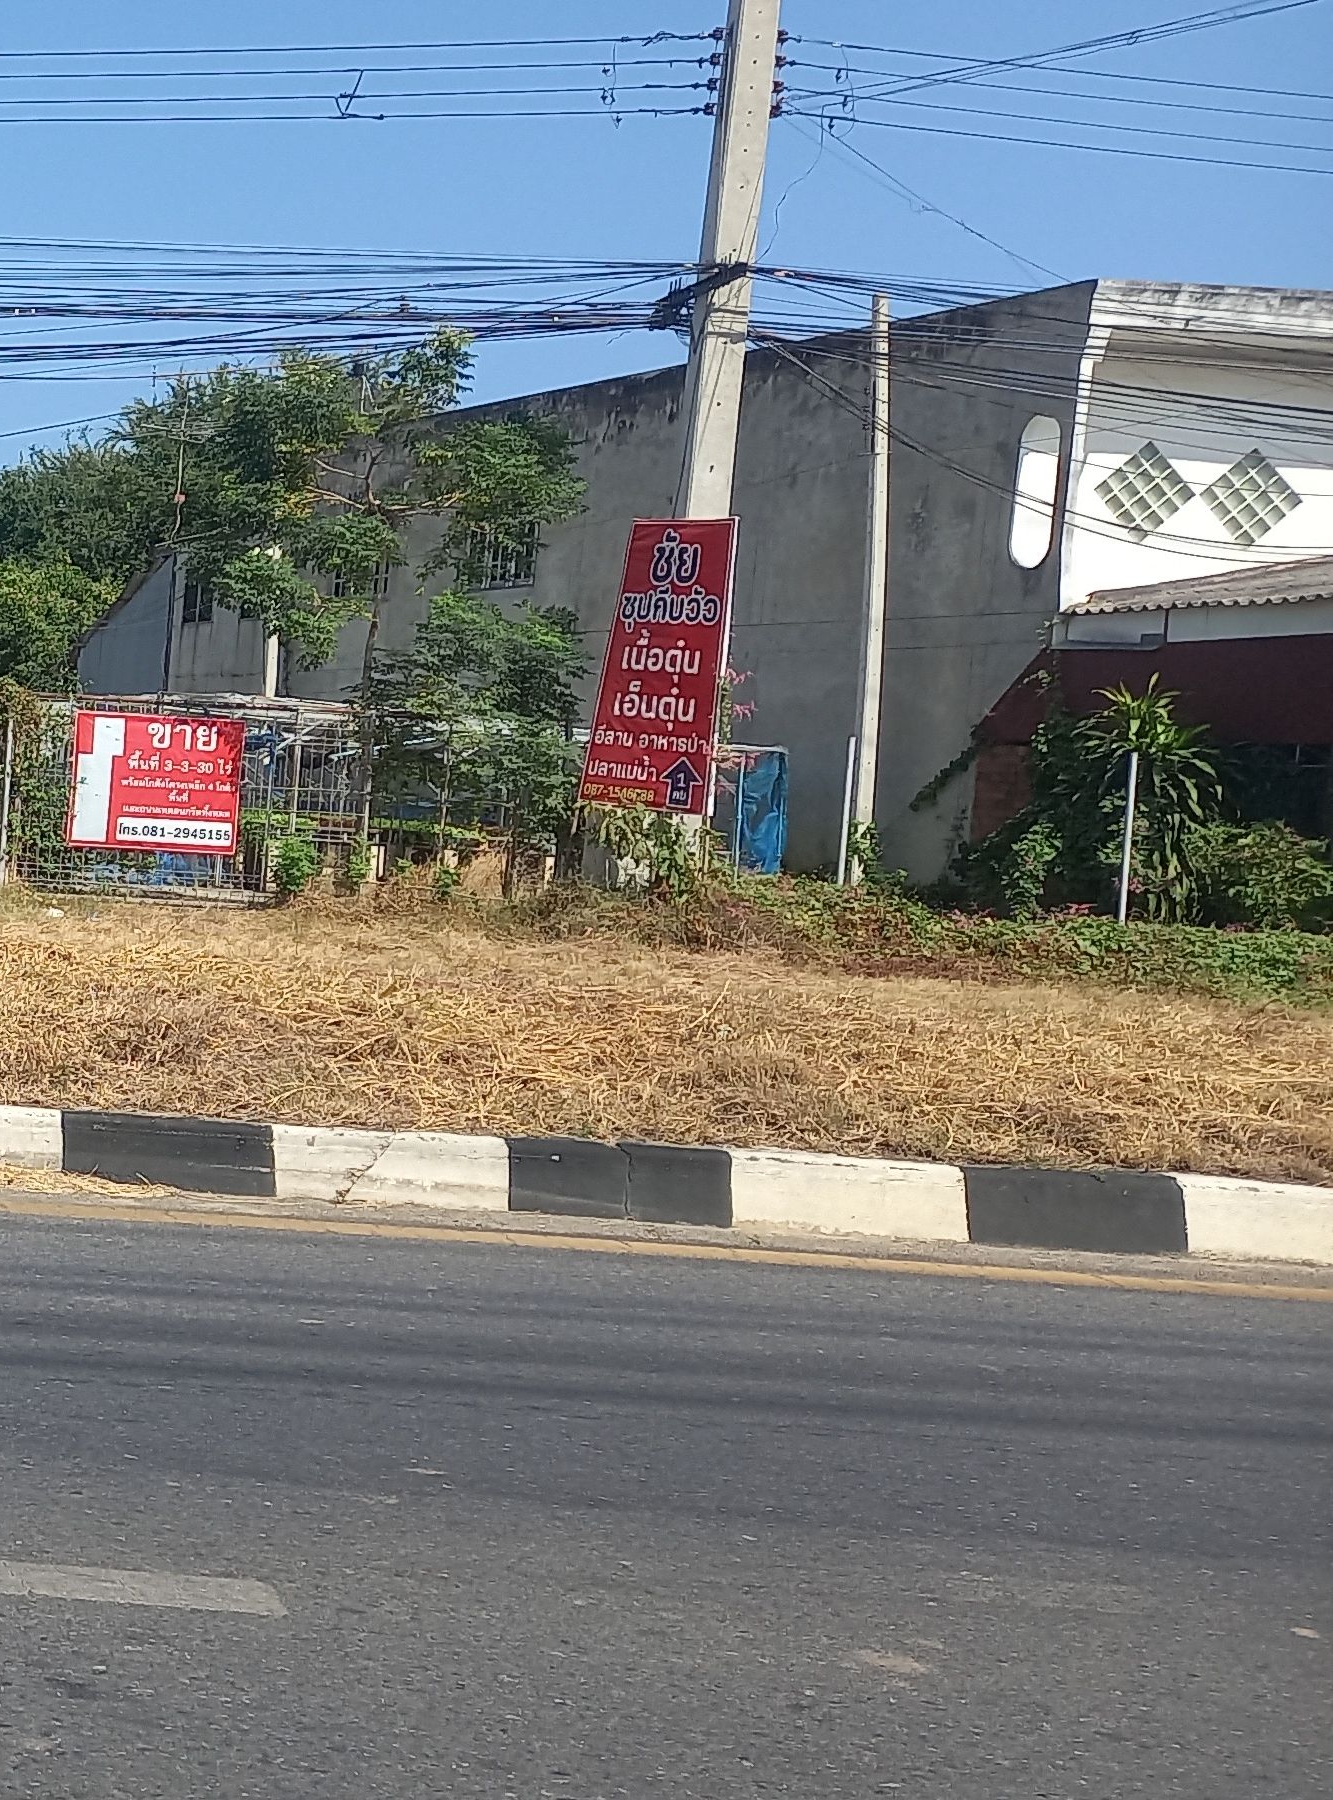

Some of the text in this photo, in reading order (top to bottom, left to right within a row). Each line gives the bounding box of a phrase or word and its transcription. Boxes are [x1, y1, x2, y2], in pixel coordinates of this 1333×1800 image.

[650, 528, 701, 586] ชัย
[622, 629, 701, 684] เนื้อตุ๋น
[613, 680, 696, 731] เอ็นตุ๋น
[147, 722, 219, 752] ขาย
[128, 749, 161, 771] พื้นที่
[163, 759, 214, 774] 3-3-30
[588, 755, 657, 782] ปลาแม่น้ำ
[677, 772, 687, 788] 1
[118, 822, 230, 841] โทร.081-2945155
